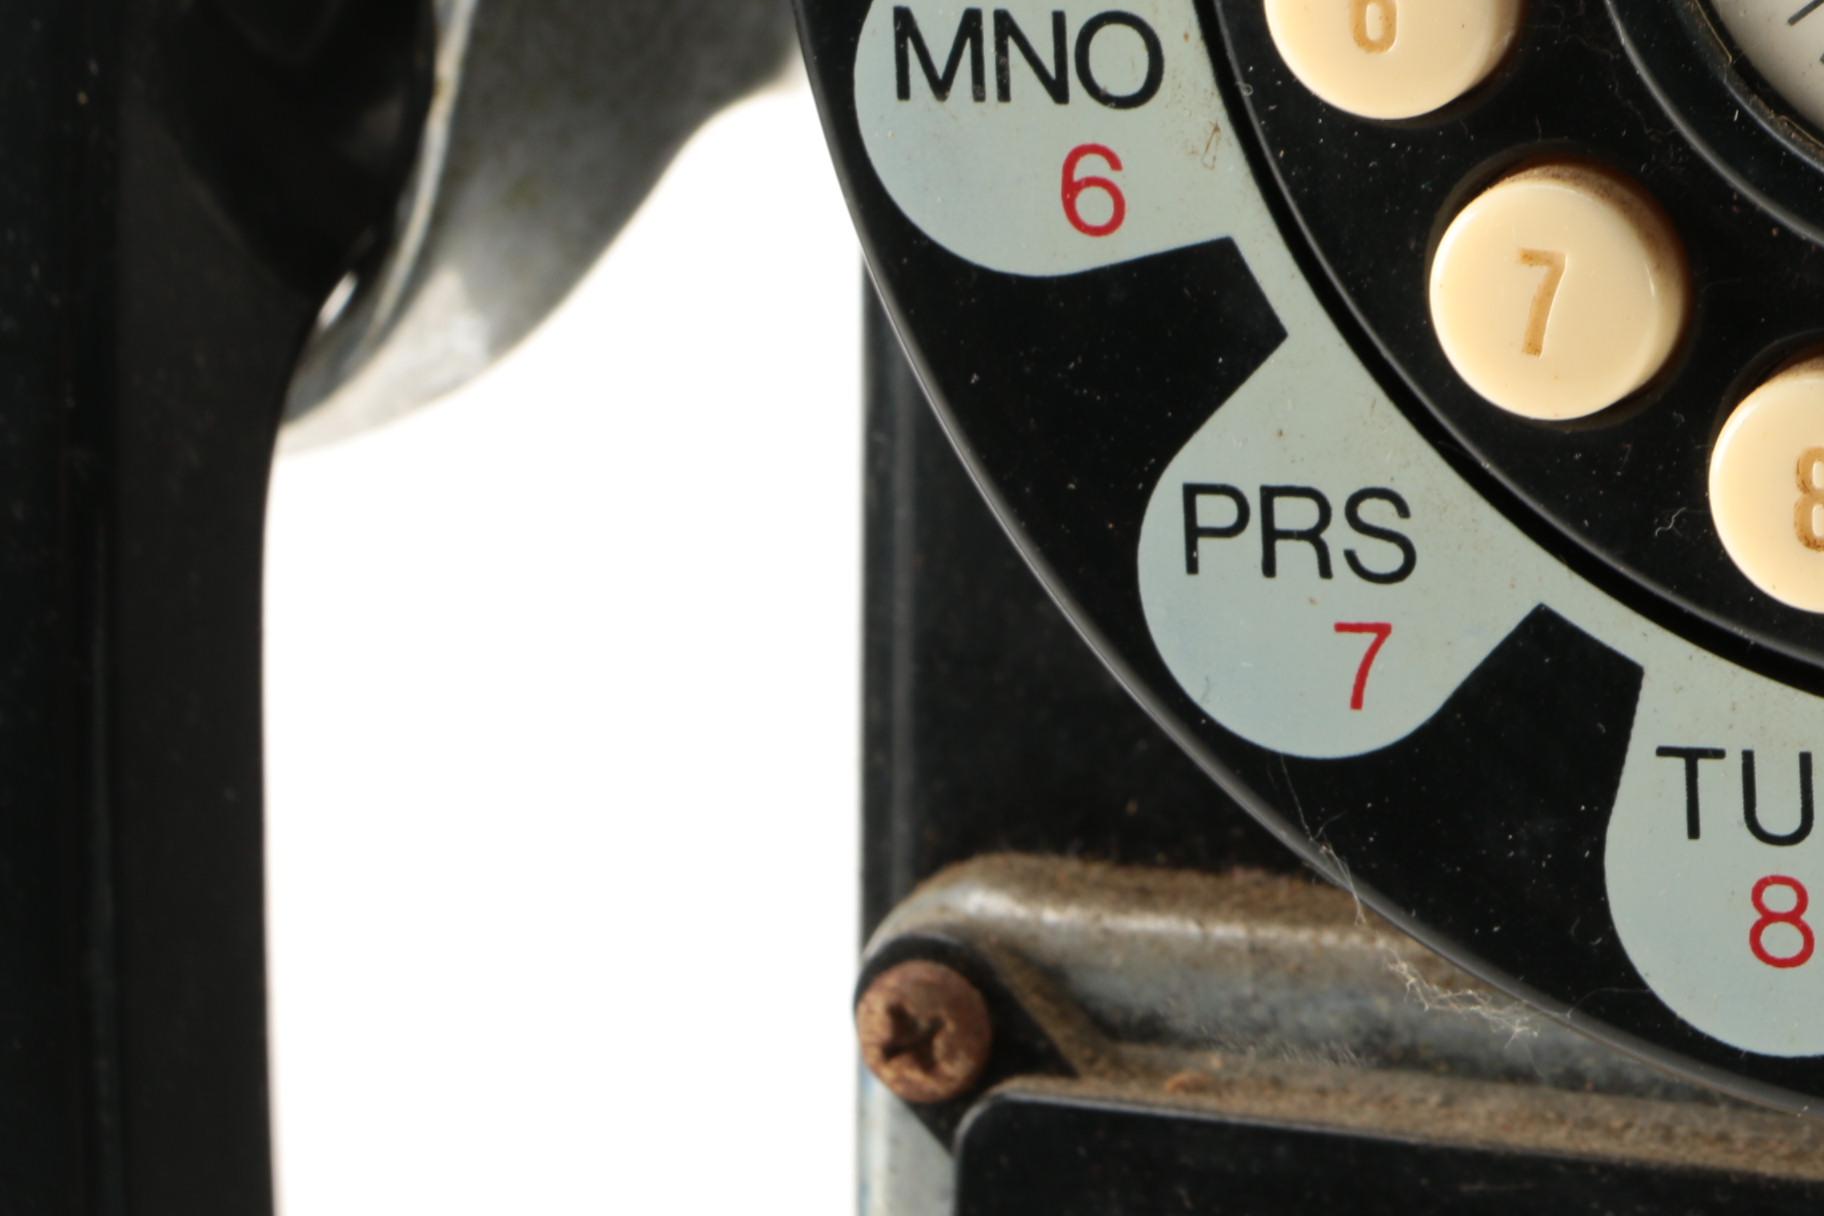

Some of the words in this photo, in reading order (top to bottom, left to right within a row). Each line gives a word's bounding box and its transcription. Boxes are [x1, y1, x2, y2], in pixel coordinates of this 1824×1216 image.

[894, 6, 1163, 109] MNO
[1062, 144, 1125, 237] 6
[1520, 249, 1563, 357] 7
[1183, 483, 1416, 584] PRS
[1336, 622, 1391, 709] 7
[1751, 876, 1814, 968] 8
